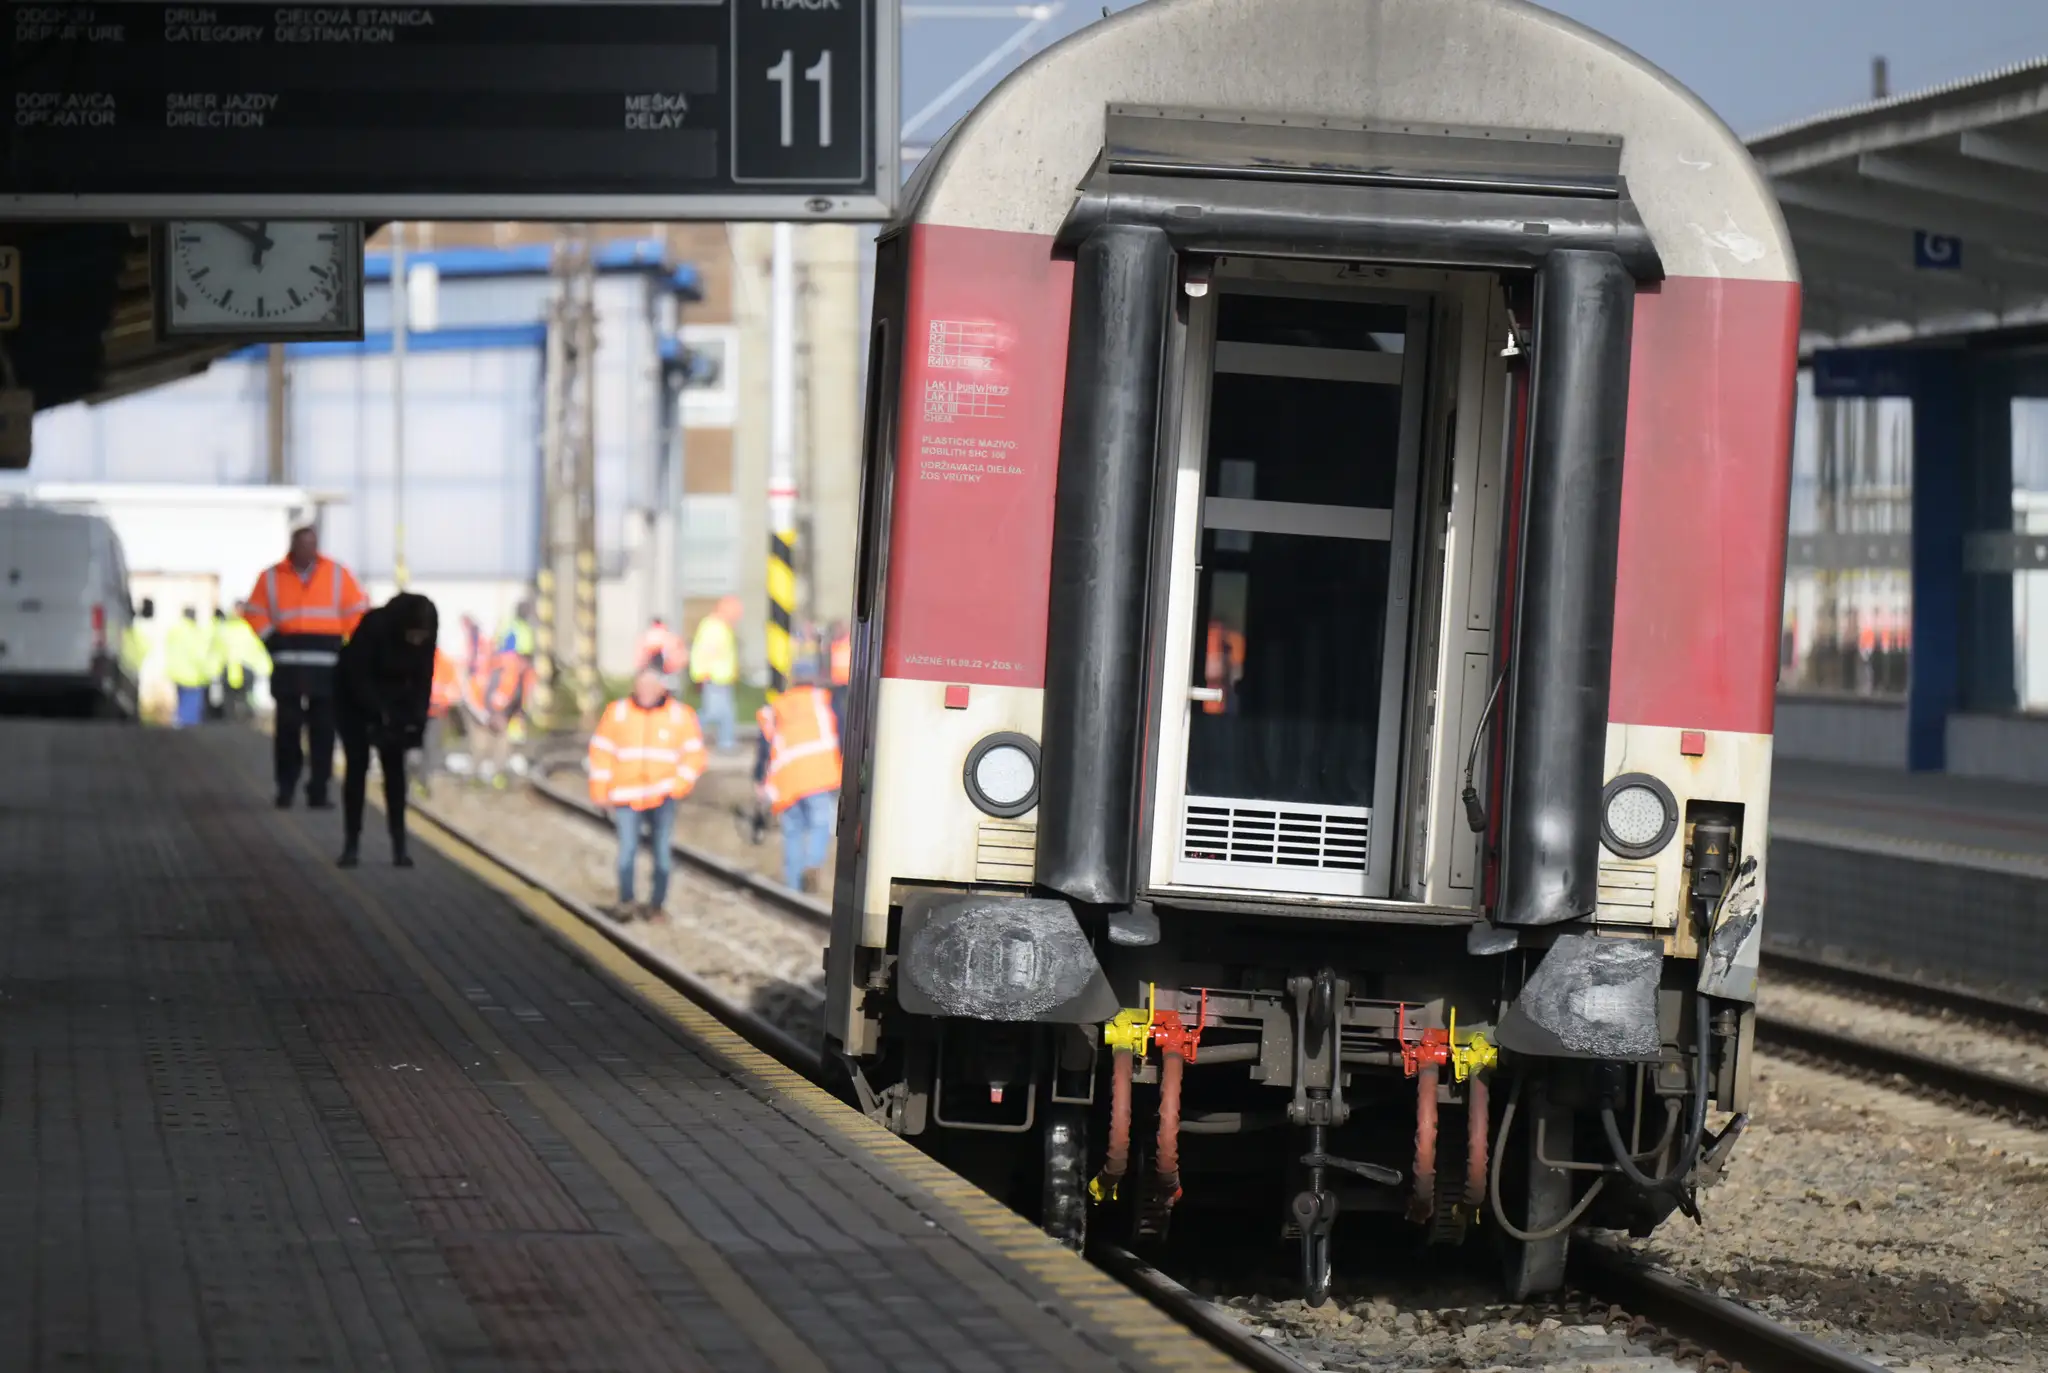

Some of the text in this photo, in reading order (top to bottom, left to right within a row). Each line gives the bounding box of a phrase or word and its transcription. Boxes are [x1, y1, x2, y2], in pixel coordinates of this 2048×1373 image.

[165, 8, 217, 24] DRUH
[357, 9, 434, 25] STANICA
[16, 25, 124, 41] DEPRURE
[165, 25, 264, 42] CATEGORY
[274, 26, 395, 42] DESTINATION
[166, 93, 279, 111] SMER JAZDY
[767, 50, 832, 147] 11
[166, 110, 264, 127] DIRECTION
[625, 113, 684, 130] DELAY
[930, 322, 943, 333] R1
[929, 333, 944, 344] R2
[929, 344, 943, 355] R3
[925, 380, 946, 391] LAK
[925, 391, 945, 402] LAK
[924, 402, 944, 413] LAK
[921, 446, 966, 458] MOBILITH
[968, 449, 988, 458] SHC
[920, 470, 940, 480] ŽOS
